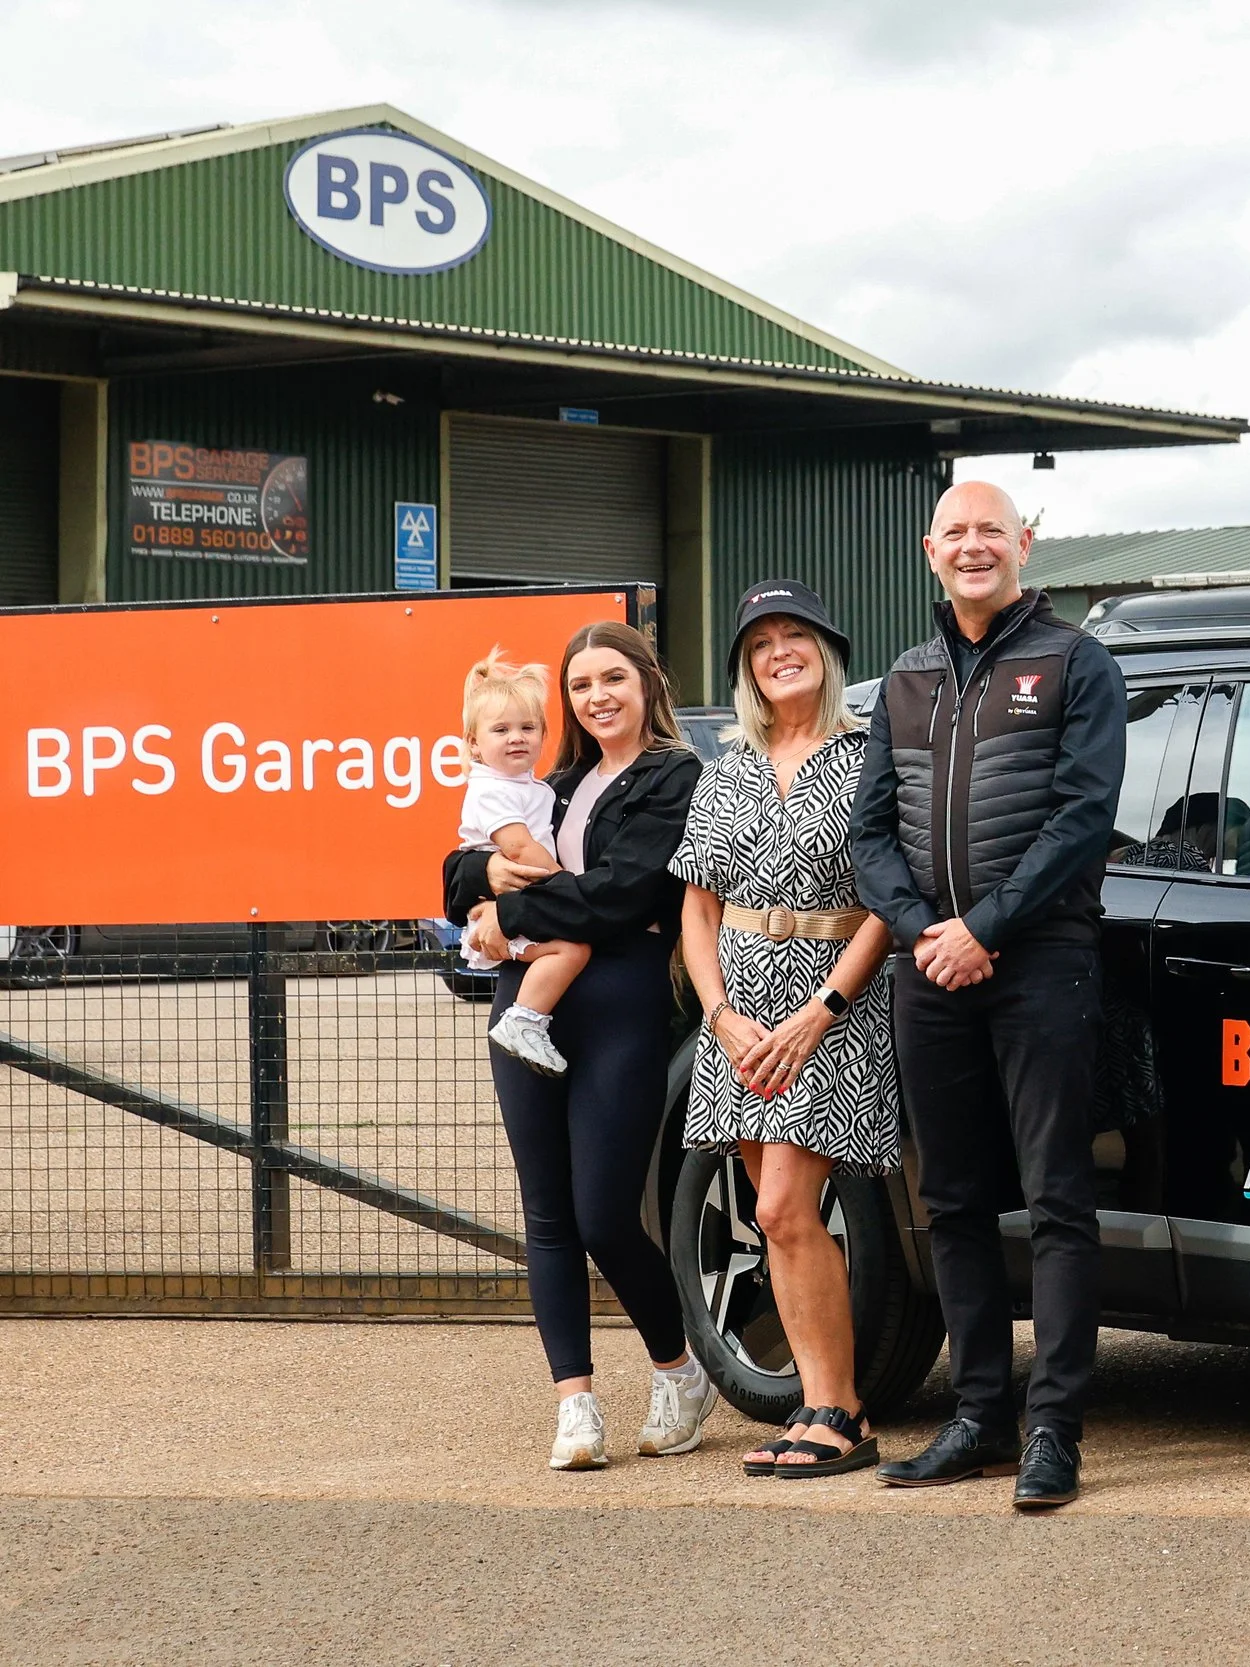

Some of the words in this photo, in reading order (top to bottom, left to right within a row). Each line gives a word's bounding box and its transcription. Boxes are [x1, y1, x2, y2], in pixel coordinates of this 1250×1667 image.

[317, 152, 457, 235] BPS
[129, 441, 196, 480] BPS
[195, 447, 270, 469] GARAGE
[195, 464, 261, 483] SERVICES
[150, 501, 257, 527] TELEPHONE:
[132, 524, 195, 546] 01889
[201, 528, 273, 550] 560100
[1011, 694, 1039, 704] YUASA
[27, 724, 176, 798] BPS
[200, 721, 468, 809] Garage
[748, 1388, 804, 1407] coContact
